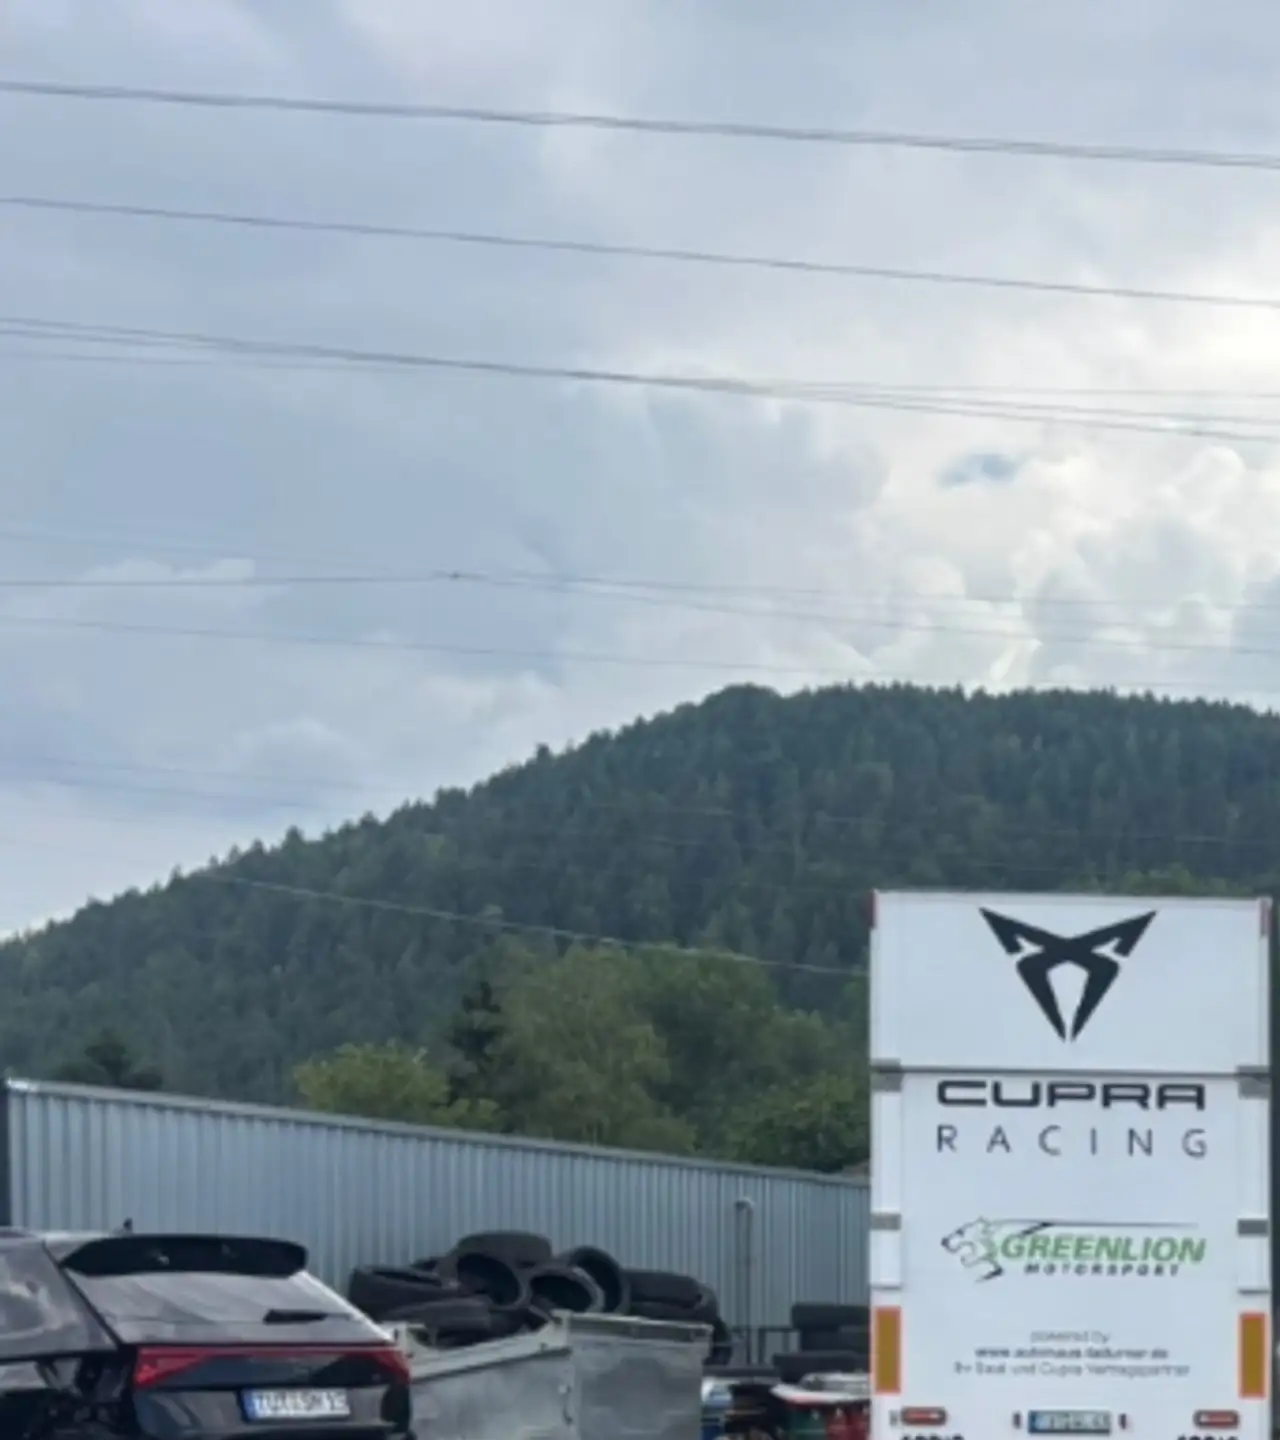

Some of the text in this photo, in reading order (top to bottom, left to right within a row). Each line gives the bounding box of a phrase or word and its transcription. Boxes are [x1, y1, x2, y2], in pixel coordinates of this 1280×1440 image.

[937, 1079, 1206, 1111] CUPRA
[937, 1123, 1207, 1158] RACING
[1000, 1235, 1206, 1264] GREENLION
[1024, 1263, 1180, 1277] MOTORSPORT
